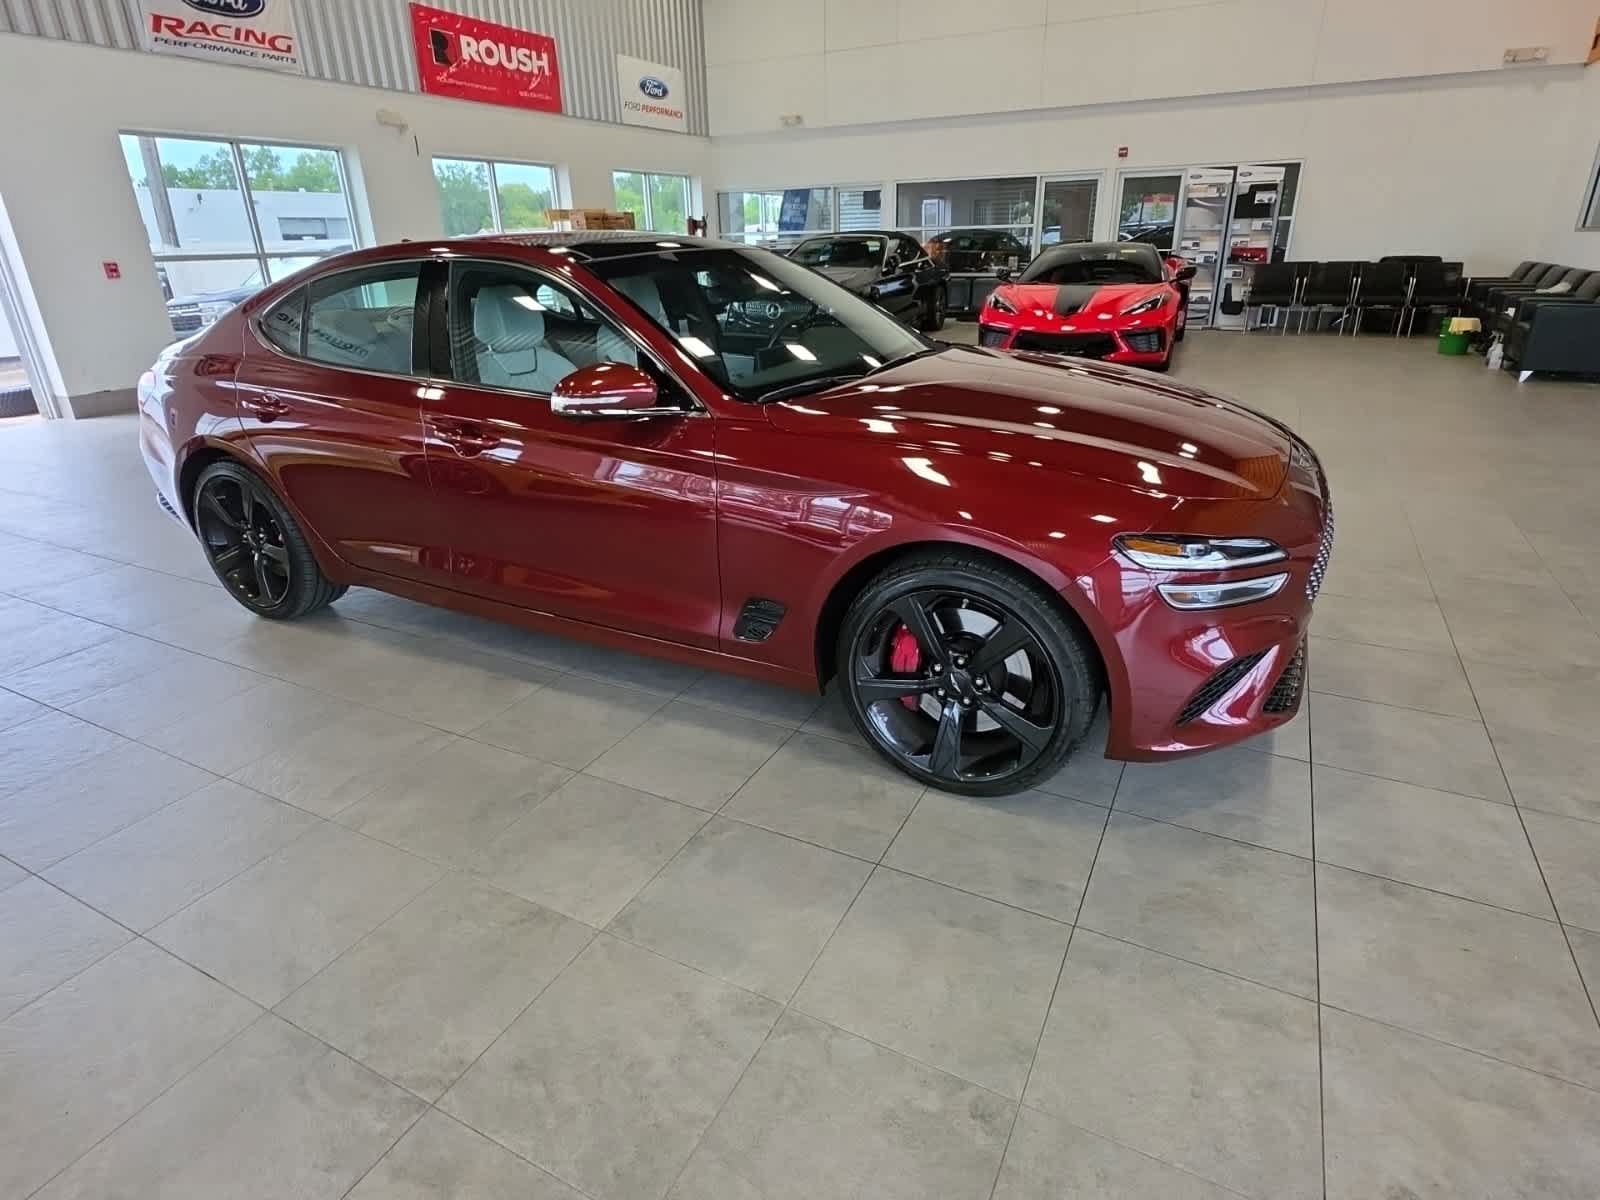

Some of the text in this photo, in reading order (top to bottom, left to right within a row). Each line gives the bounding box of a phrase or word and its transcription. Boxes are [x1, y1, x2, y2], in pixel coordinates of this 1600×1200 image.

[151, 14, 293, 53] RACING
[154, 36, 297, 64] PERFORMANCE PARTS
[459, 35, 549, 76] ROUSH
[644, 79, 664, 97] Ford
